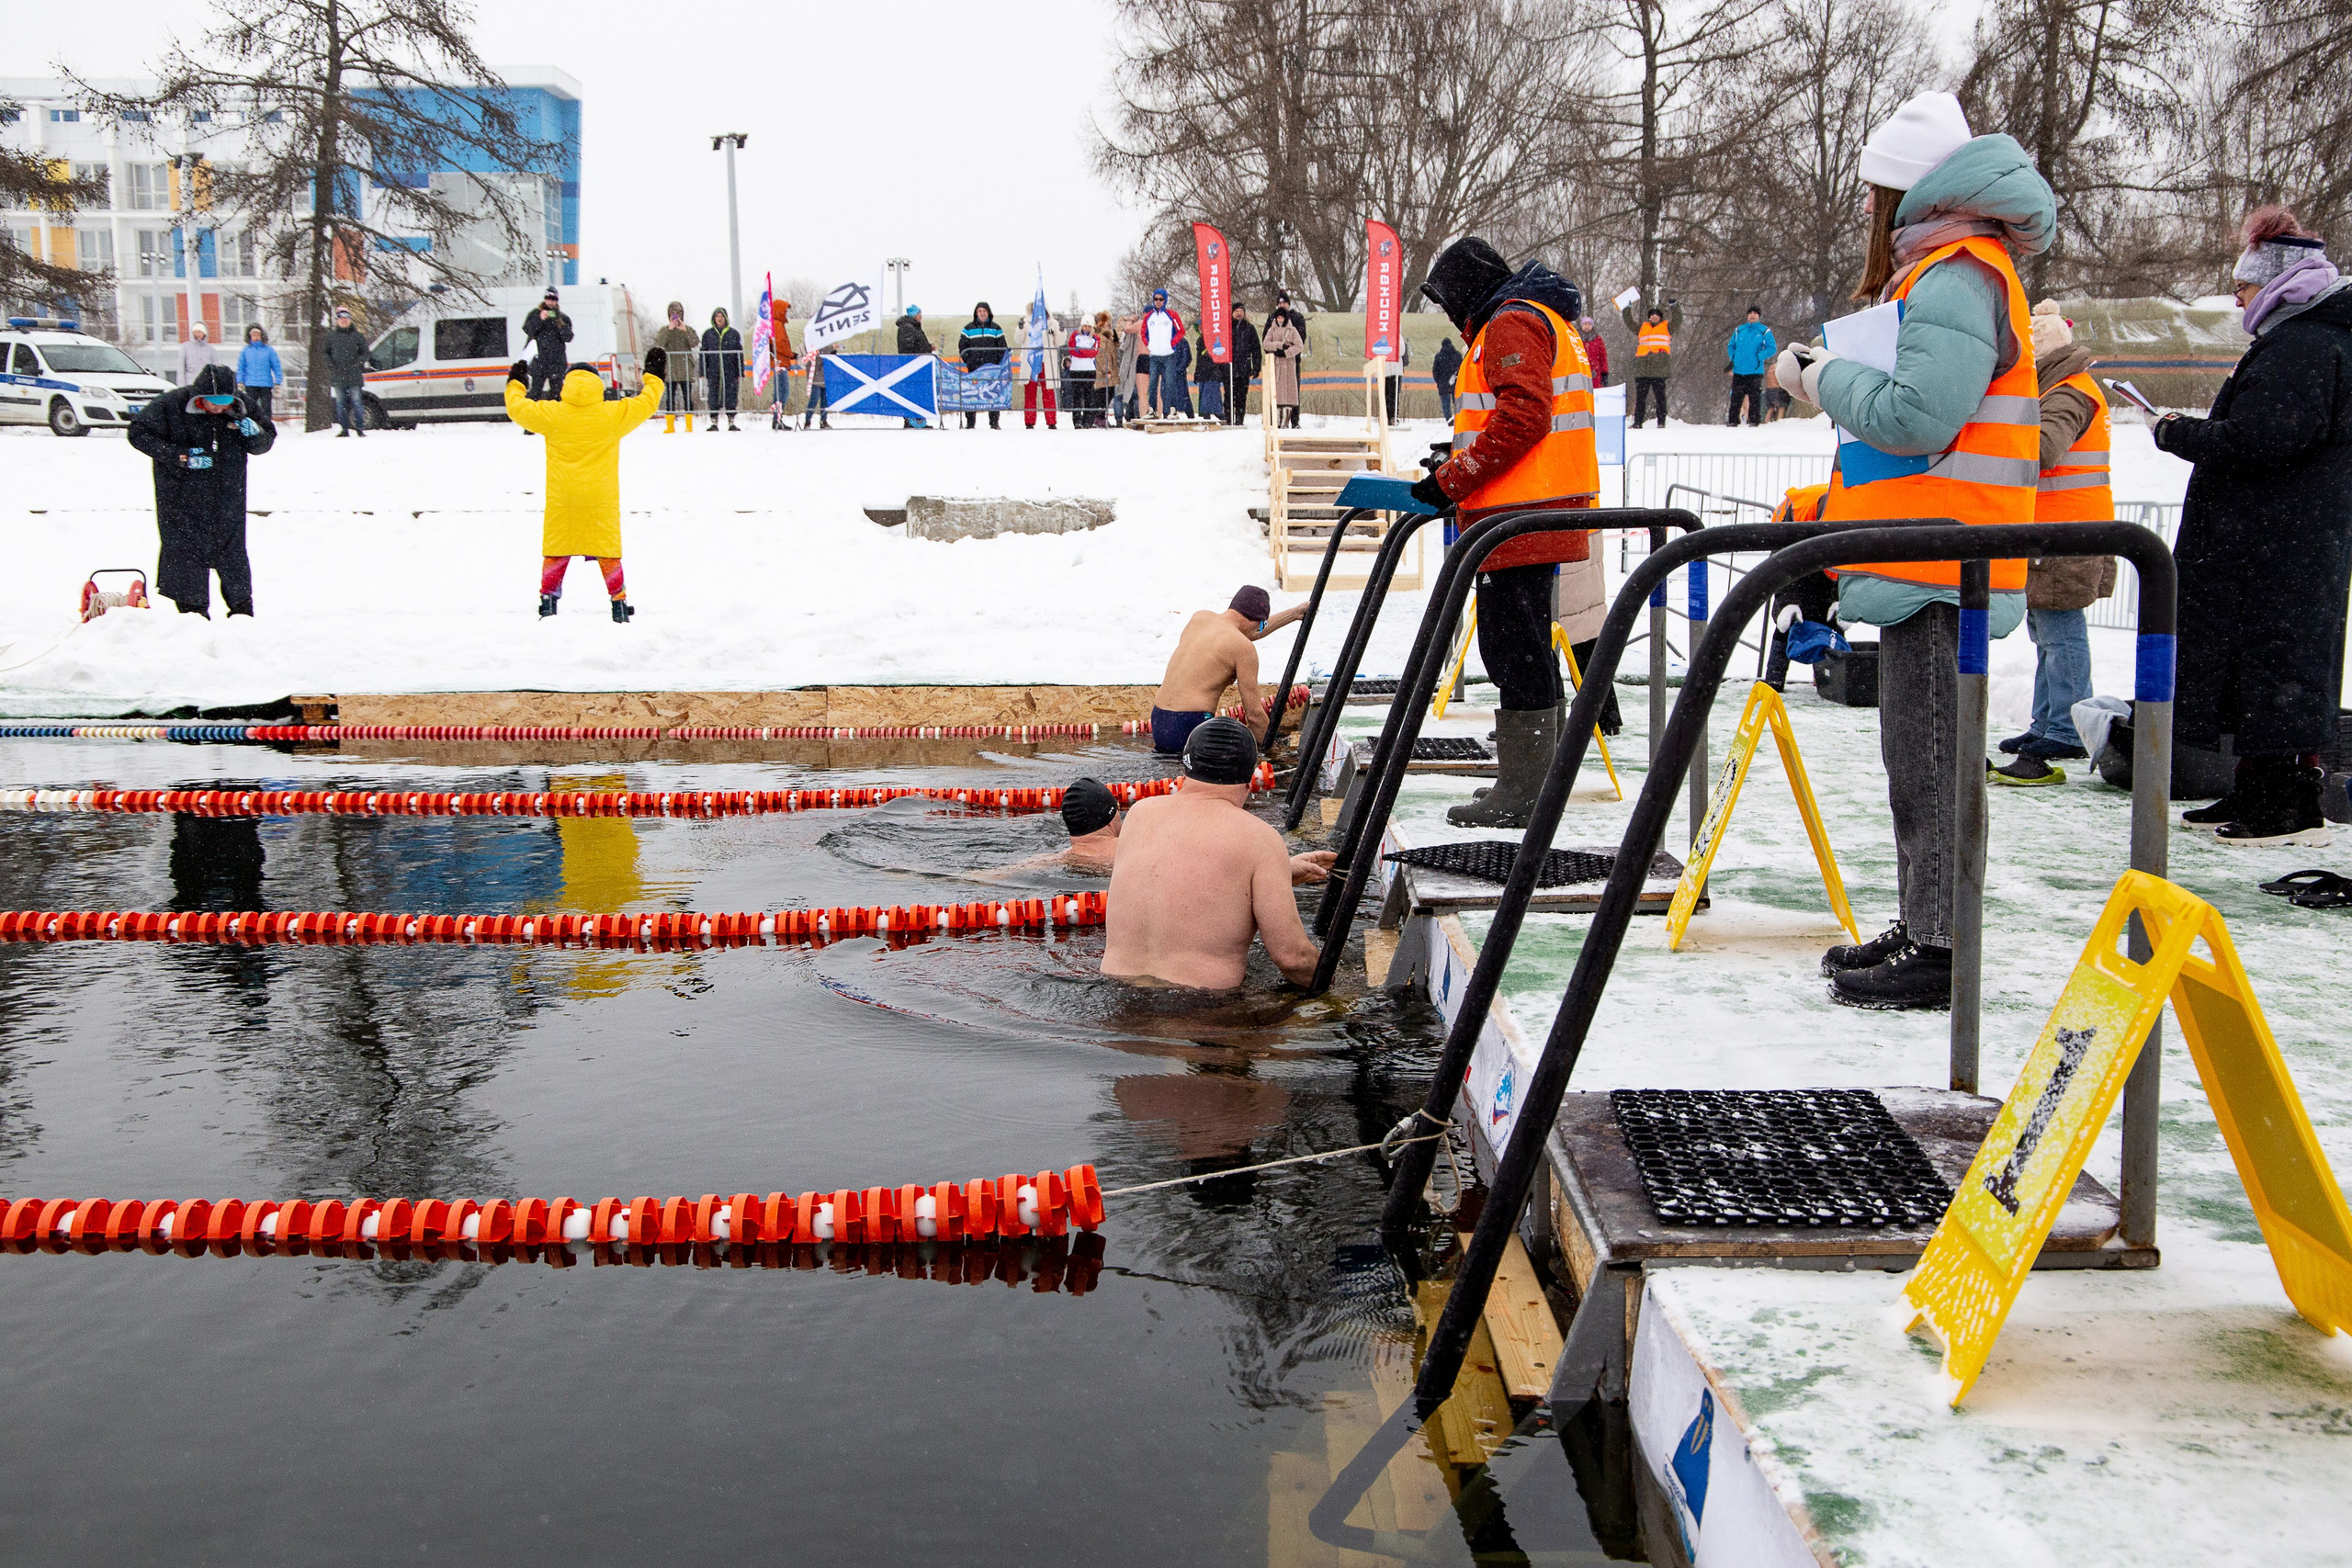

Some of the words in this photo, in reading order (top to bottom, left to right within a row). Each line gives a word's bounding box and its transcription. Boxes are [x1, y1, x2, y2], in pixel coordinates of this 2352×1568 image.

[1210, 264, 1221, 334] МОСКВА
[1379, 262, 1390, 333] МОСКВА
[1983, 1024, 2098, 1218] 1
